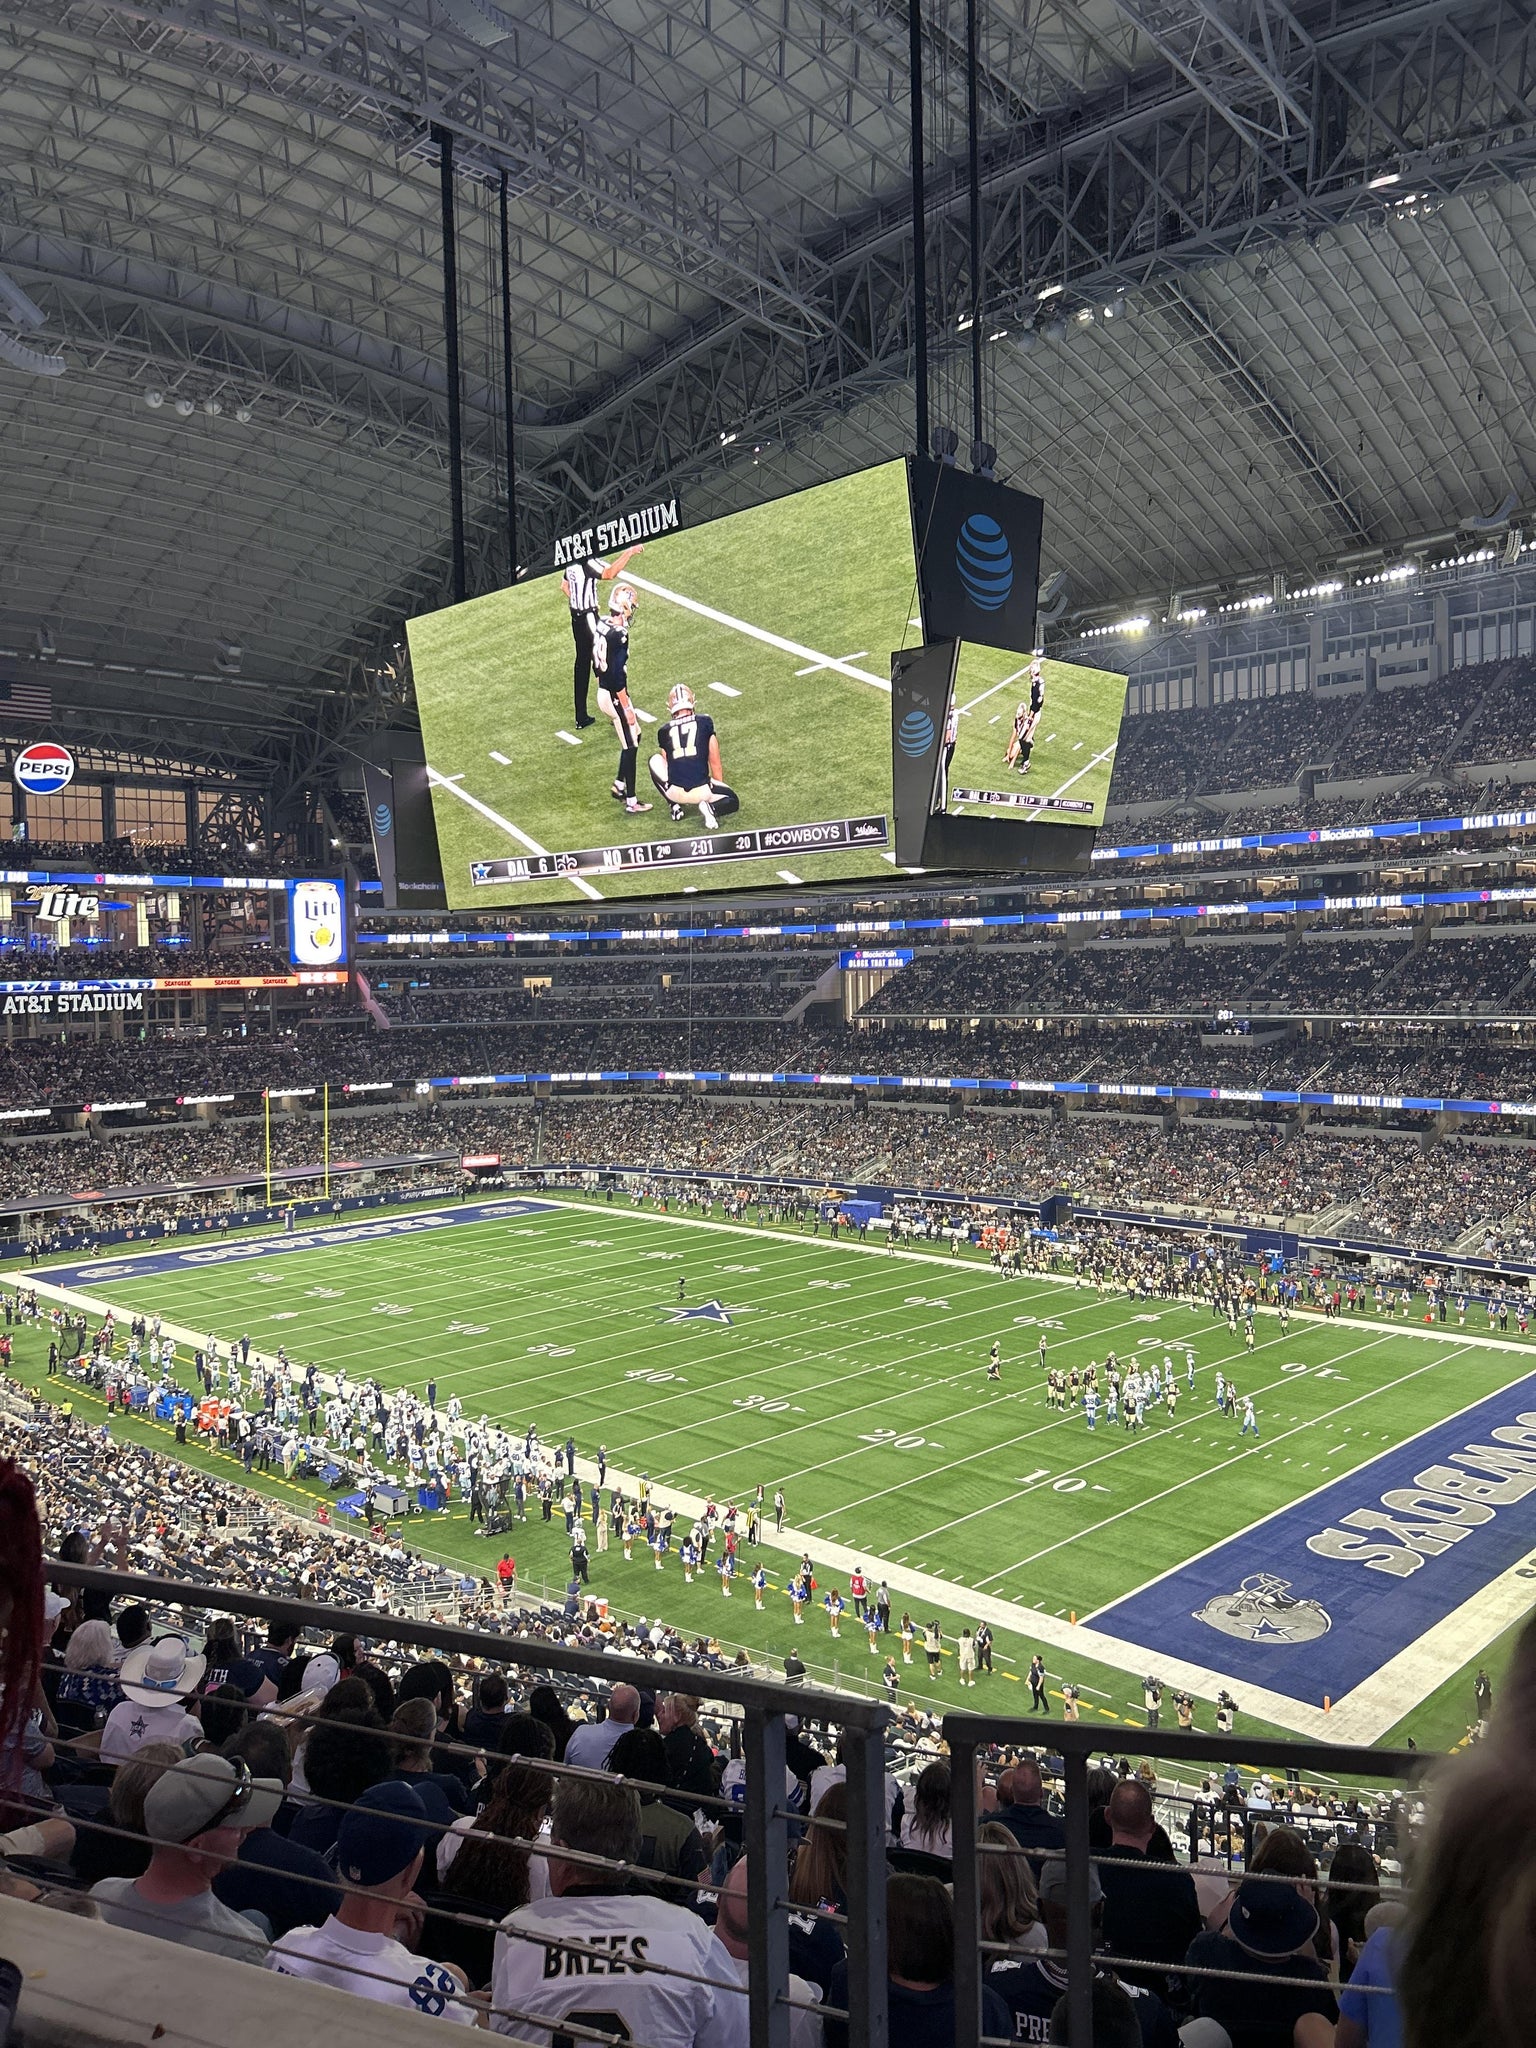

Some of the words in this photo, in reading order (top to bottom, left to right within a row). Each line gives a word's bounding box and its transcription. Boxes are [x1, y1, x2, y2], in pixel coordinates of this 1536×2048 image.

[554, 528, 594, 566] AT&T
[597, 499, 679, 551] STADIUM
[668, 721, 698, 759] 17
[19, 762, 70, 776] PEPSI
[1319, 829, 1374, 840] Blockchain
[507, 859, 531, 877] DAL
[538, 857, 547, 874] 6
[602, 849, 622, 867] NO
[627, 847, 645, 865] 16
[656, 845, 671, 859] 2ND
[691, 839, 714, 856] 2:01
[735, 835, 752, 851] :20
[764, 825, 841, 847] #COWBOYS
[1382, 860, 1407, 868] EMMITT
[1491, 890, 1536, 900] Blockchai
[35, 892, 99, 922] Lite
[949, 918, 984, 926] Blockchain
[862, 951, 897, 959] Blockchain
[2, 994, 54, 1015] AT&T
[57, 992, 144, 1013] STADIUM
[1018, 1082, 1055, 1091] Blockchain
[1219, 1090, 1263, 1100] Blockchain
[1501, 1102, 1536, 1115] Blockc
[445, 1320, 490, 1335] 40
[526, 1342, 576, 1357] 50
[624, 1368, 675, 1383] 40
[732, 1394, 791, 1413] 30
[857, 1428, 926, 1449] 20
[1014, 1468, 1088, 1493] 10
[543, 1935, 650, 1980] BREES
